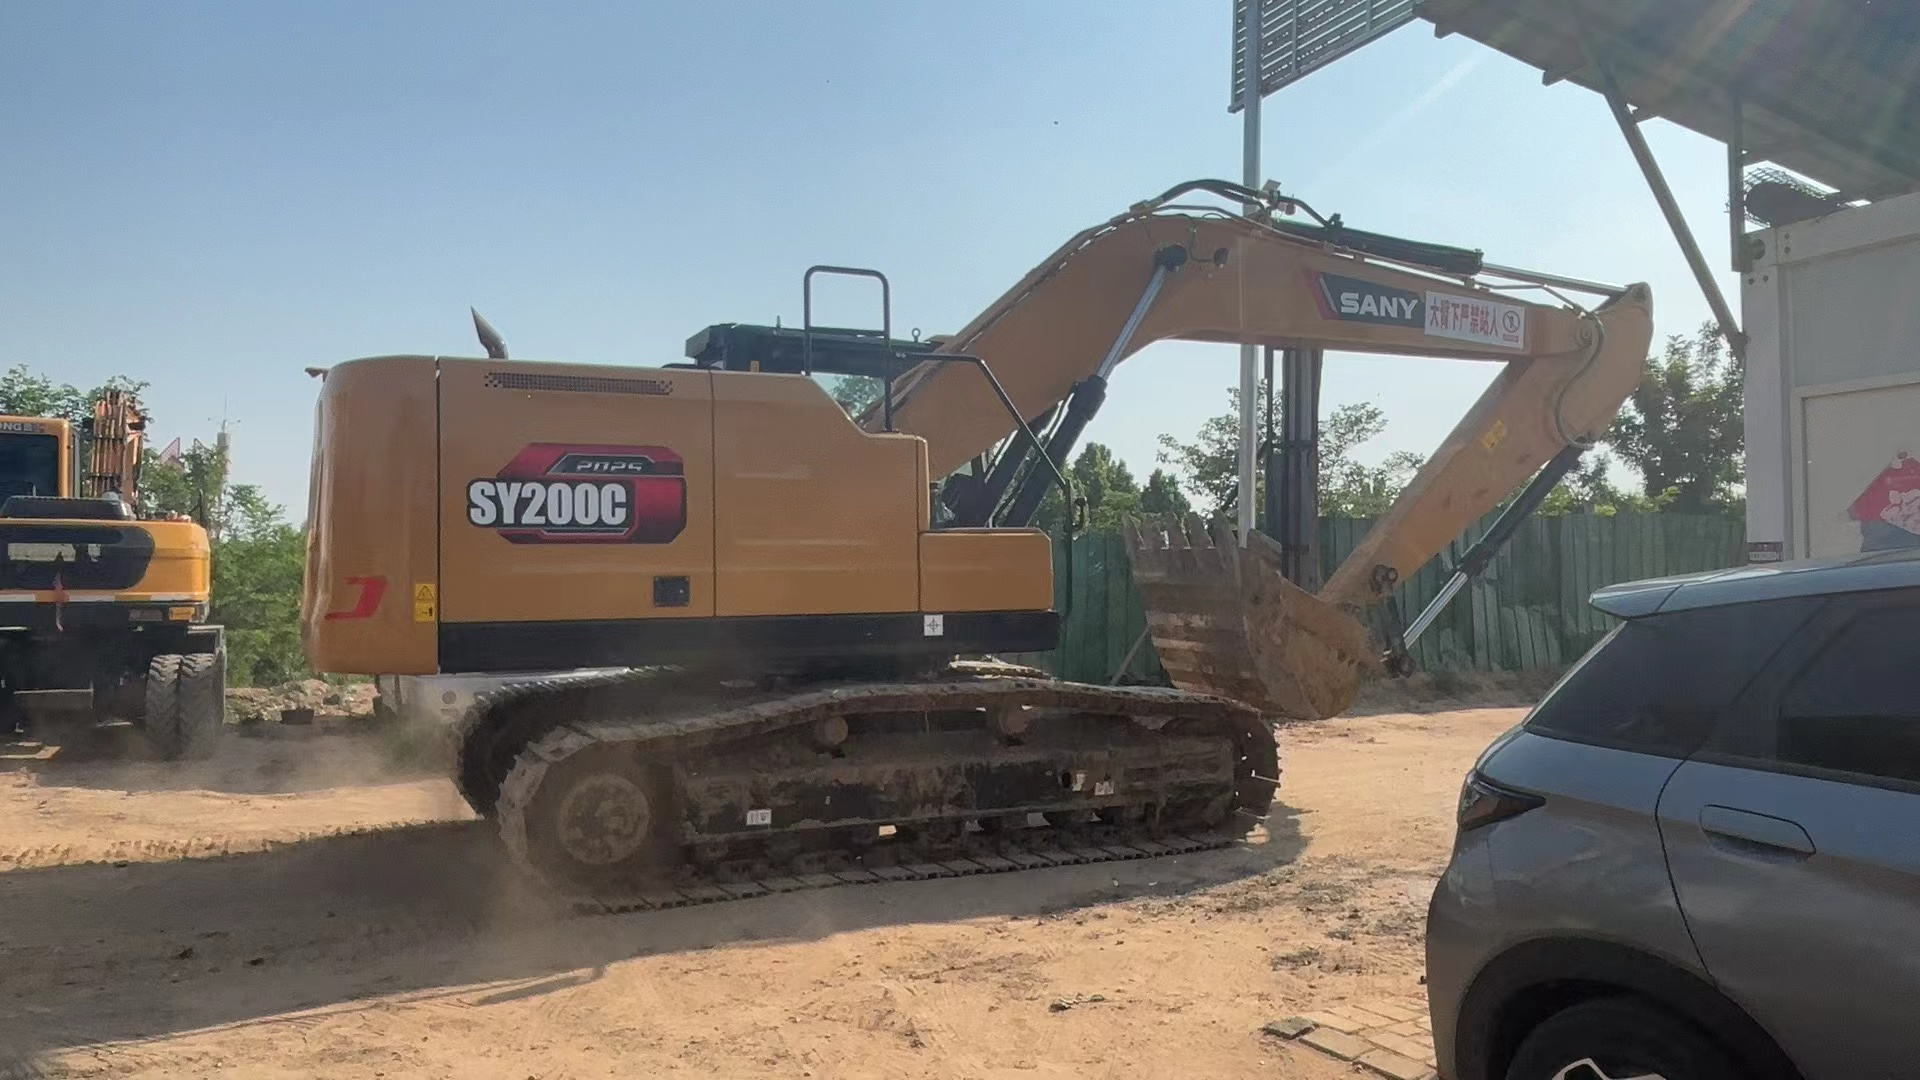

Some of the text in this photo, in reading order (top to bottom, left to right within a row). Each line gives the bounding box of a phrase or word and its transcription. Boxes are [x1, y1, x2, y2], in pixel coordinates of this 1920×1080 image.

[1340, 292, 1418, 319] SANY
[1429, 296, 1499, 337] 大臂下严禁站人
[576, 462, 642, 472] 2025
[469, 481, 626, 525] SY200C
